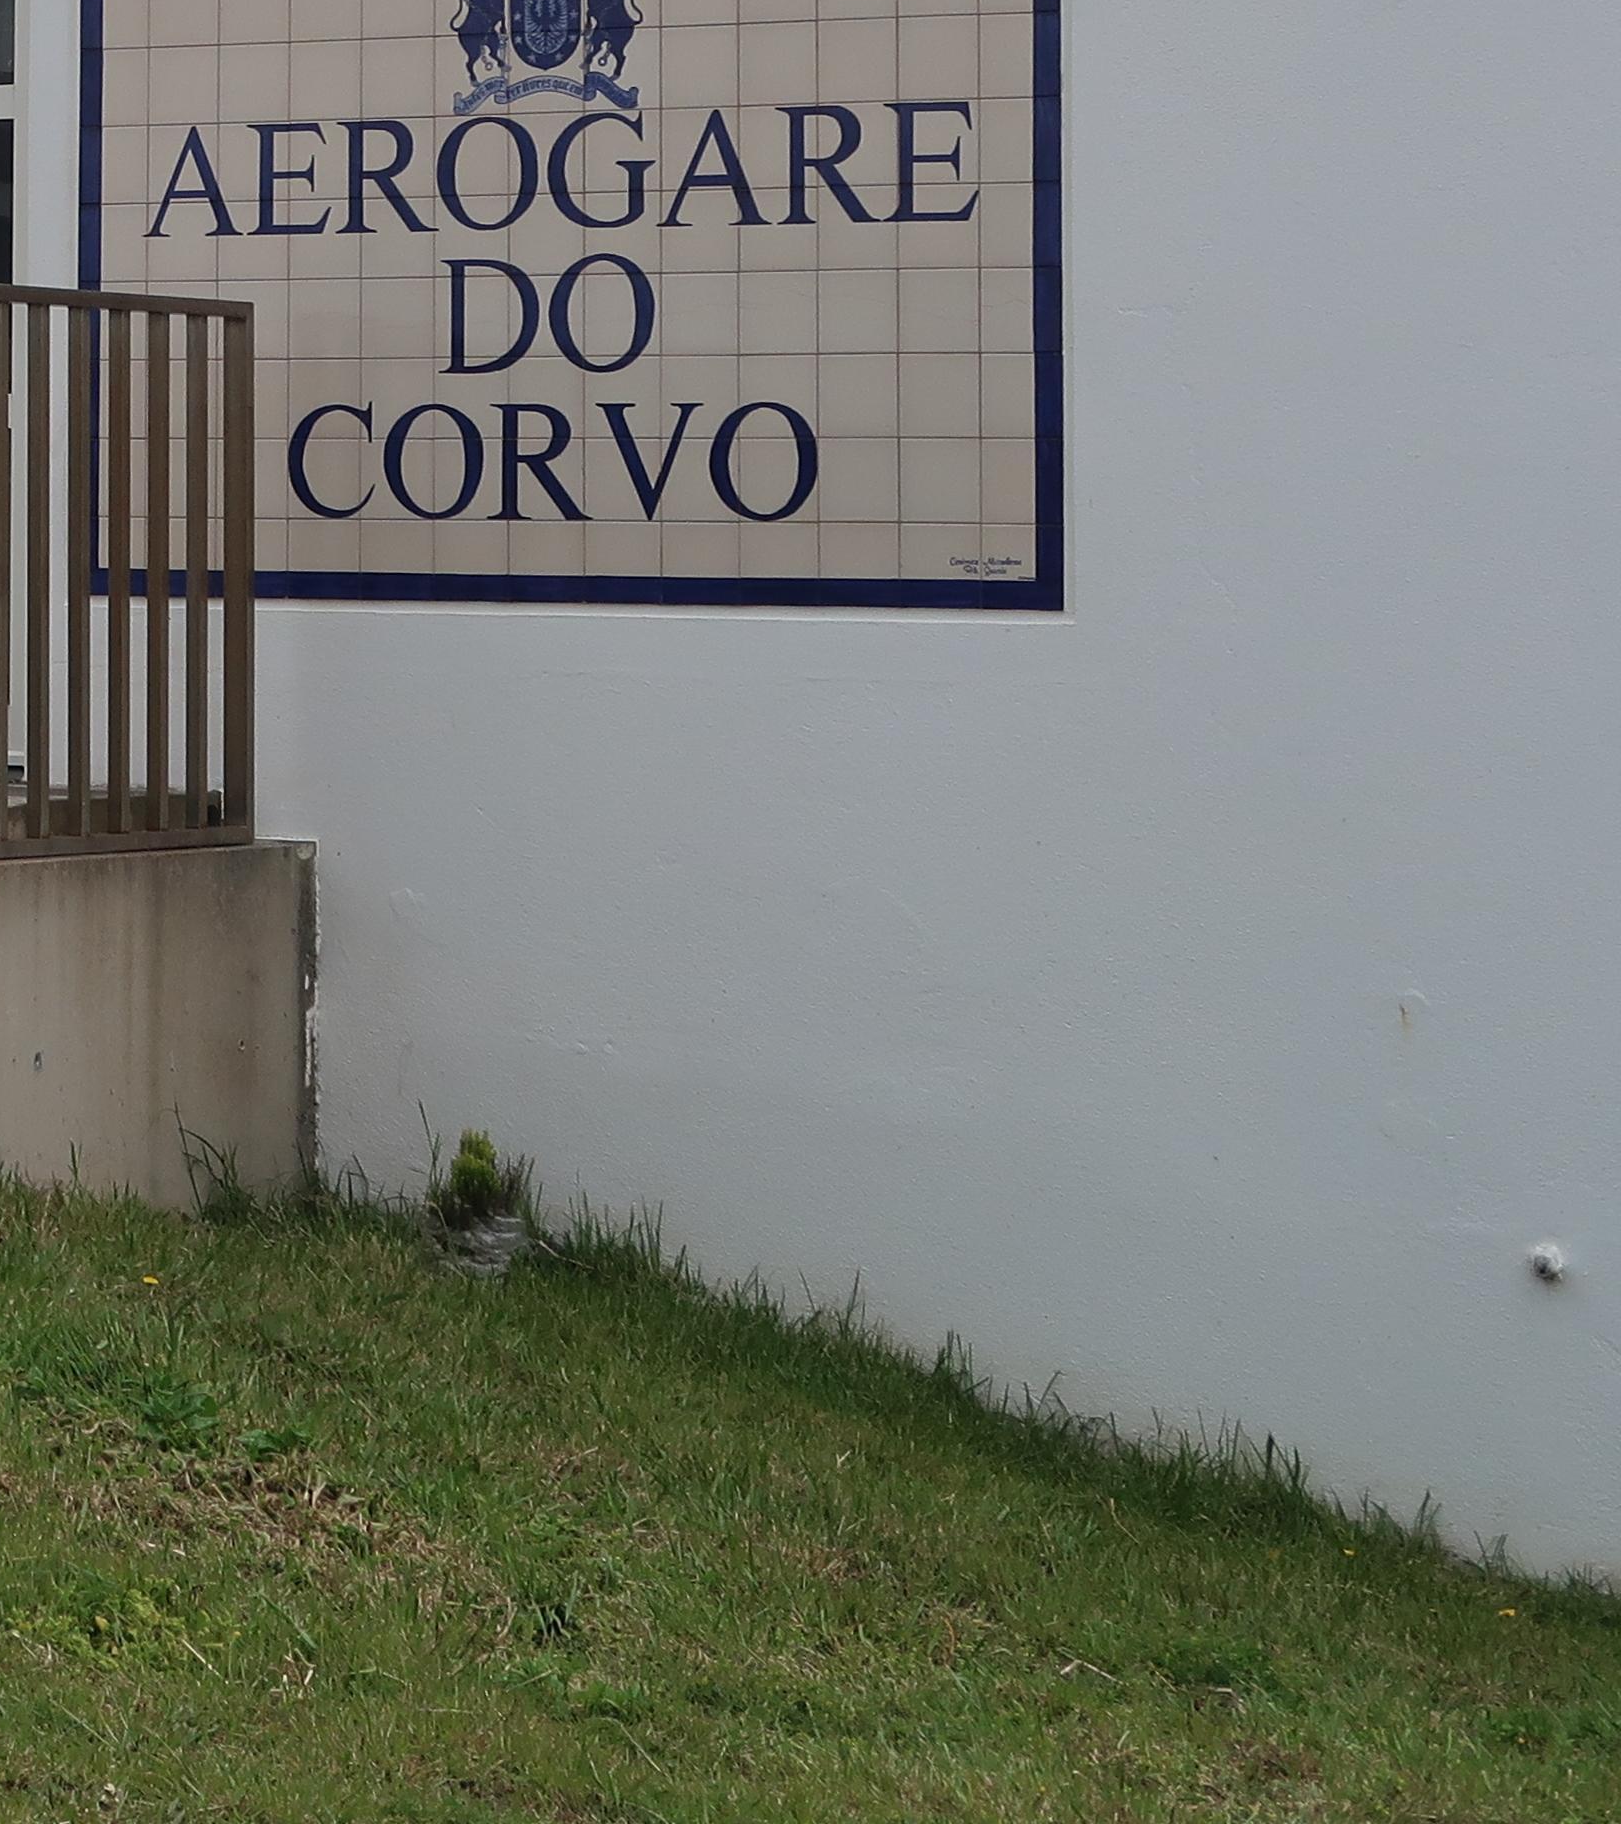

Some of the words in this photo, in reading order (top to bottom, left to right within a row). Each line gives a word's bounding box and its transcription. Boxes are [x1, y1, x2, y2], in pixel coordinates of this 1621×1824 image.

[143, 102, 980, 237] AEROGARE
[438, 253, 655, 374] DO
[288, 401, 819, 522] CORVO
